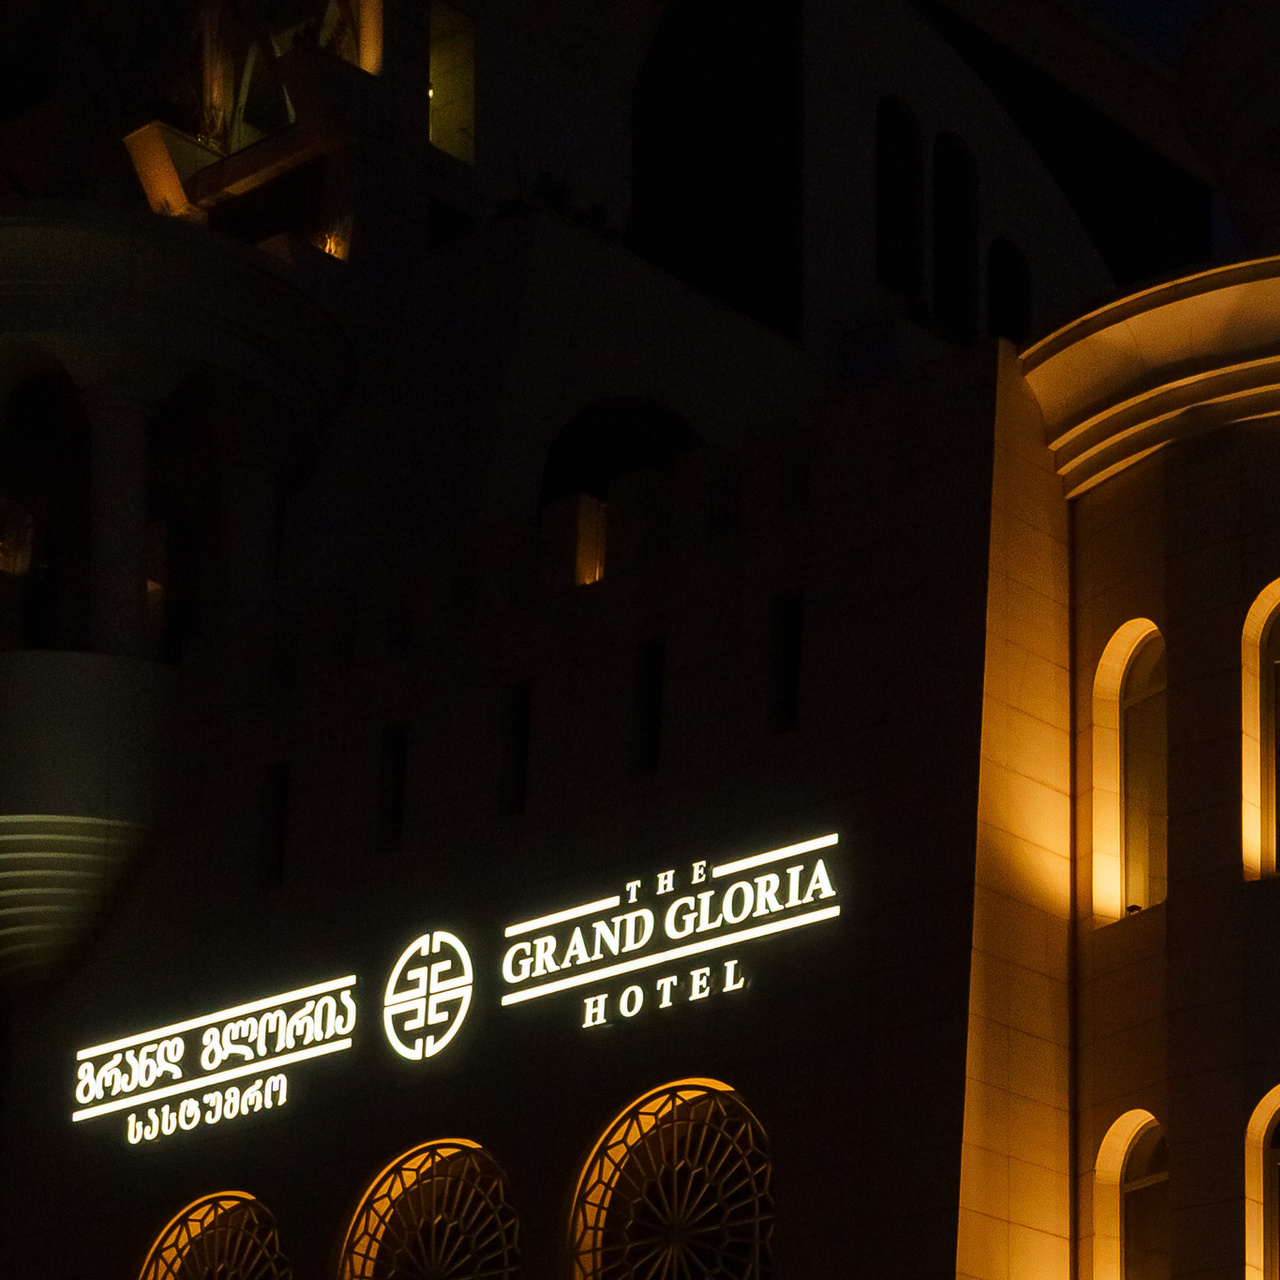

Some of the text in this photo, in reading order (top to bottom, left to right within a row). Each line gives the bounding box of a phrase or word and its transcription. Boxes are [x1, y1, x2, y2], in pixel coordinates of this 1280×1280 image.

[626, 861, 706, 903] THE
[502, 859, 836, 983] GRAND GLORIA
[582, 960, 745, 1028] HOTEL
[76, 990, 357, 1104] გრანდ გლორია
[127, 1073, 288, 1145] სასტუმრო
